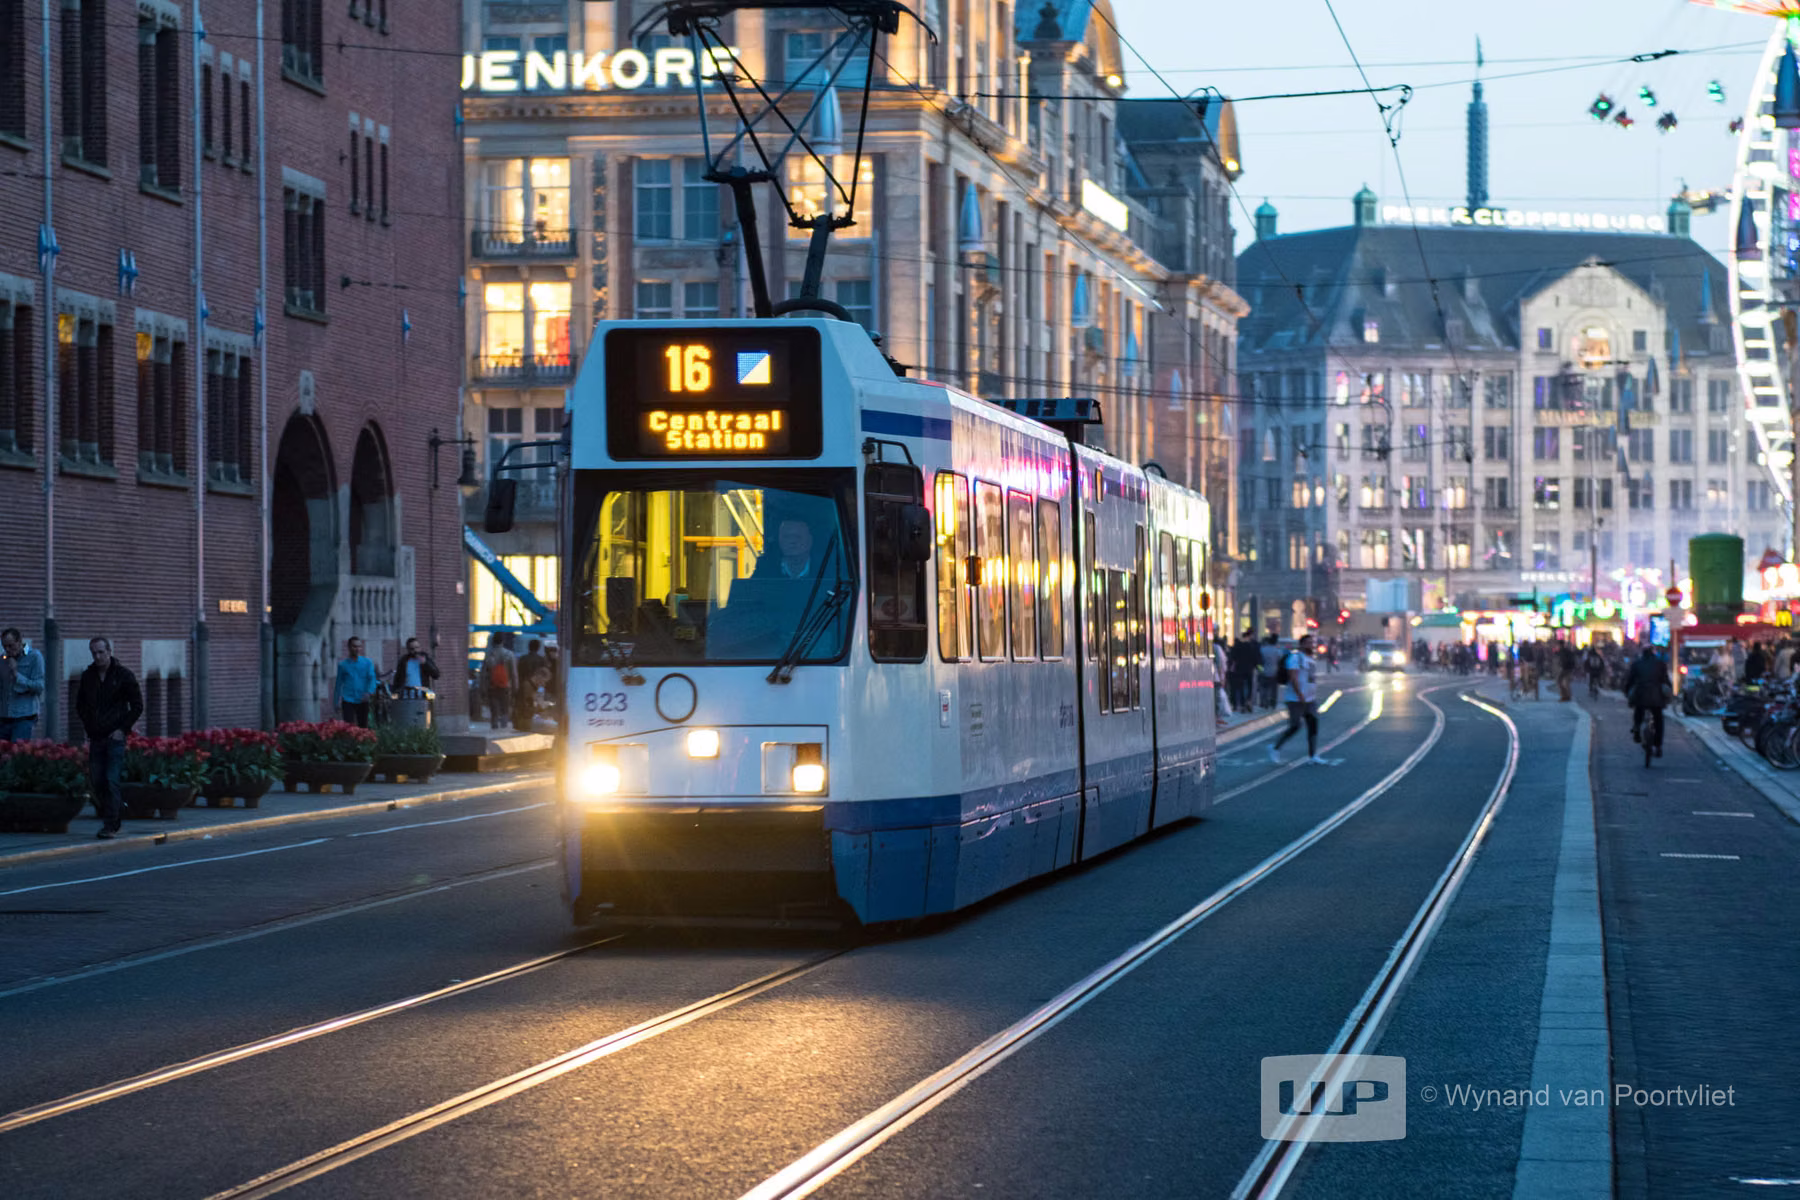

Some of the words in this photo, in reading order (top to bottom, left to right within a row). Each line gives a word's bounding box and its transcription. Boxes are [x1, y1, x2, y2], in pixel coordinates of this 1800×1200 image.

[665, 345, 711, 392] 16
[649, 410, 781, 431] Centraal
[666, 429, 766, 449] Station
[584, 692, 629, 712] 823
